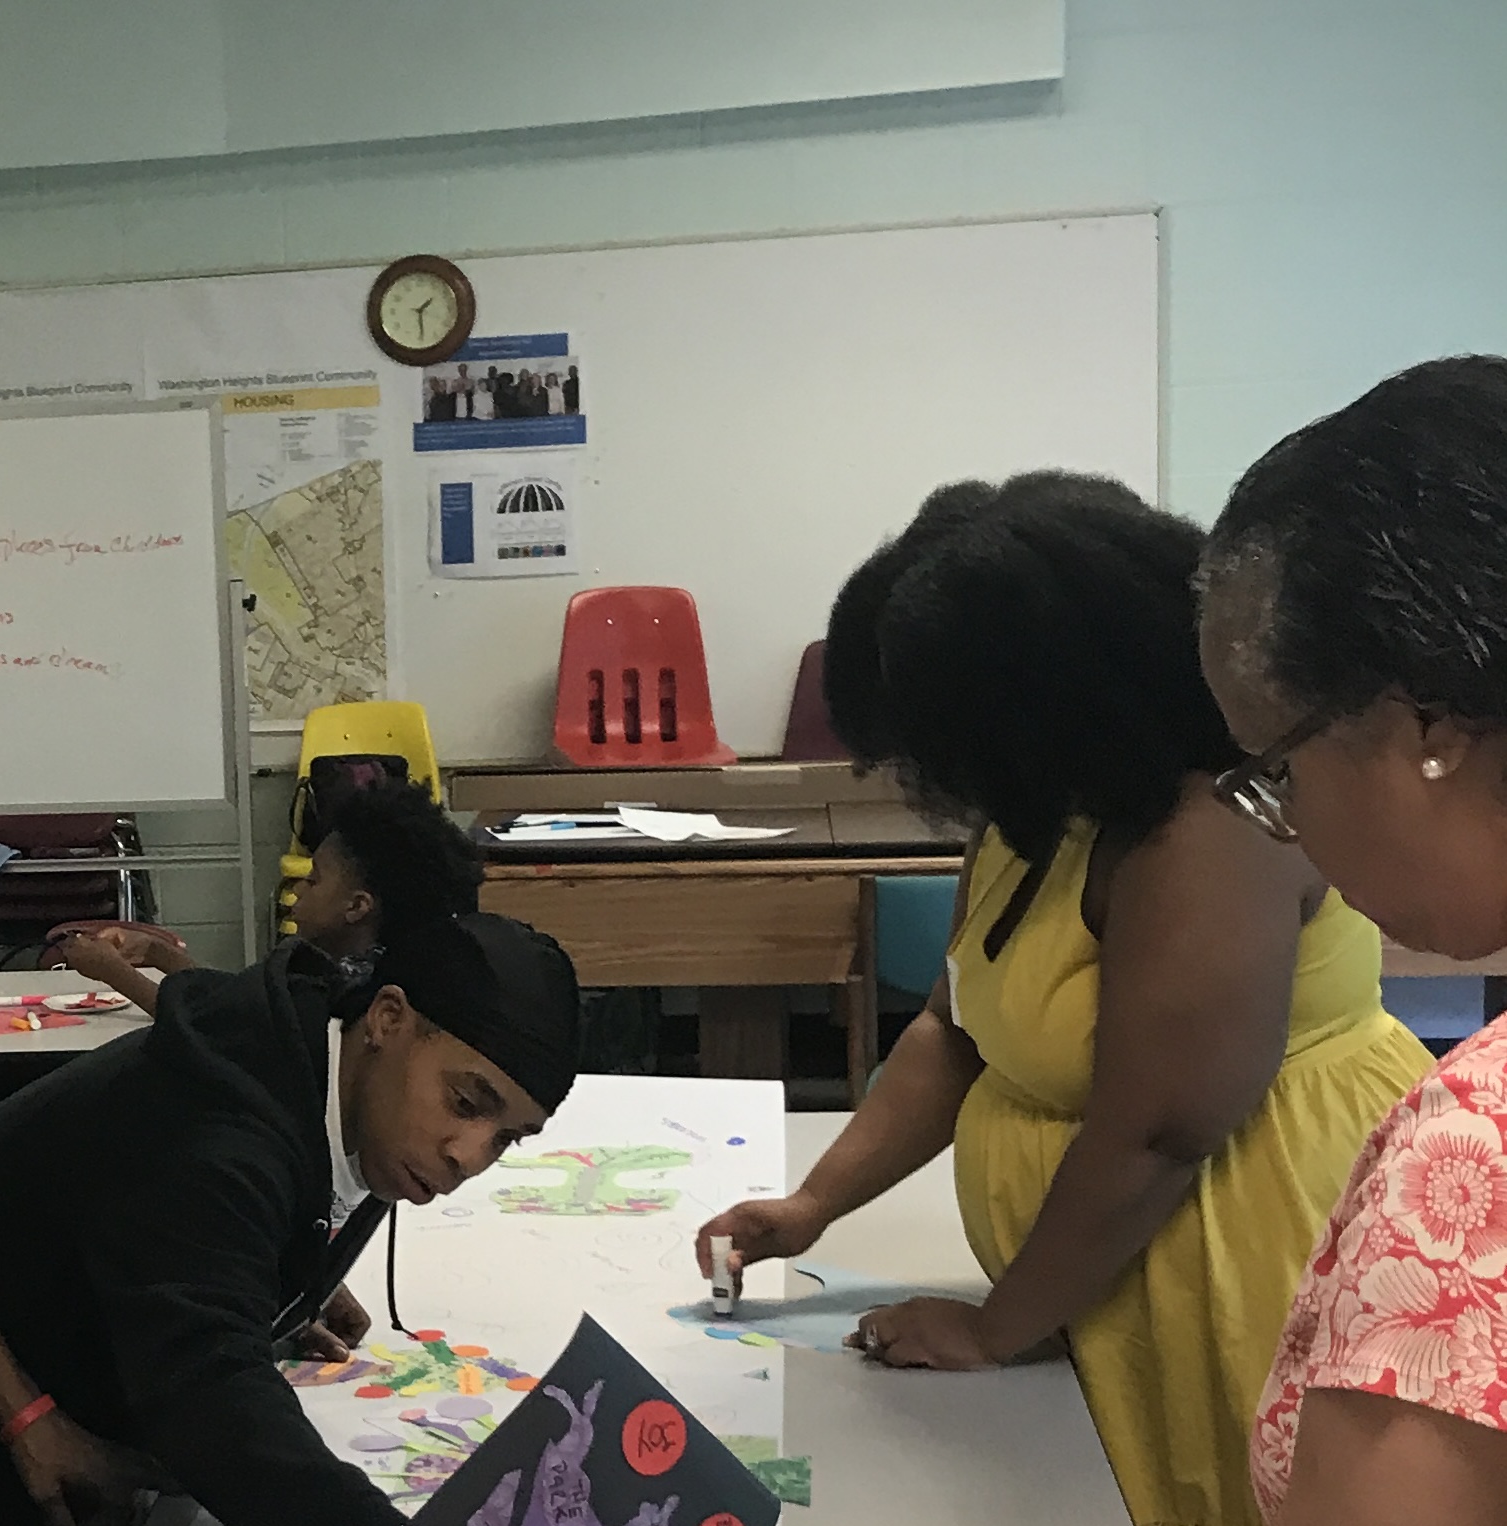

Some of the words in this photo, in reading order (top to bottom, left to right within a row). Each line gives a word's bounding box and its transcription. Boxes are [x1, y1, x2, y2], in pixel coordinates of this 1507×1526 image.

[160, 377, 220, 391] Washington
[223, 375, 263, 388] Heights
[317, 369, 377, 383] Community
[74, 381, 133, 395] Community
[233, 394, 294, 408] HOUSING
